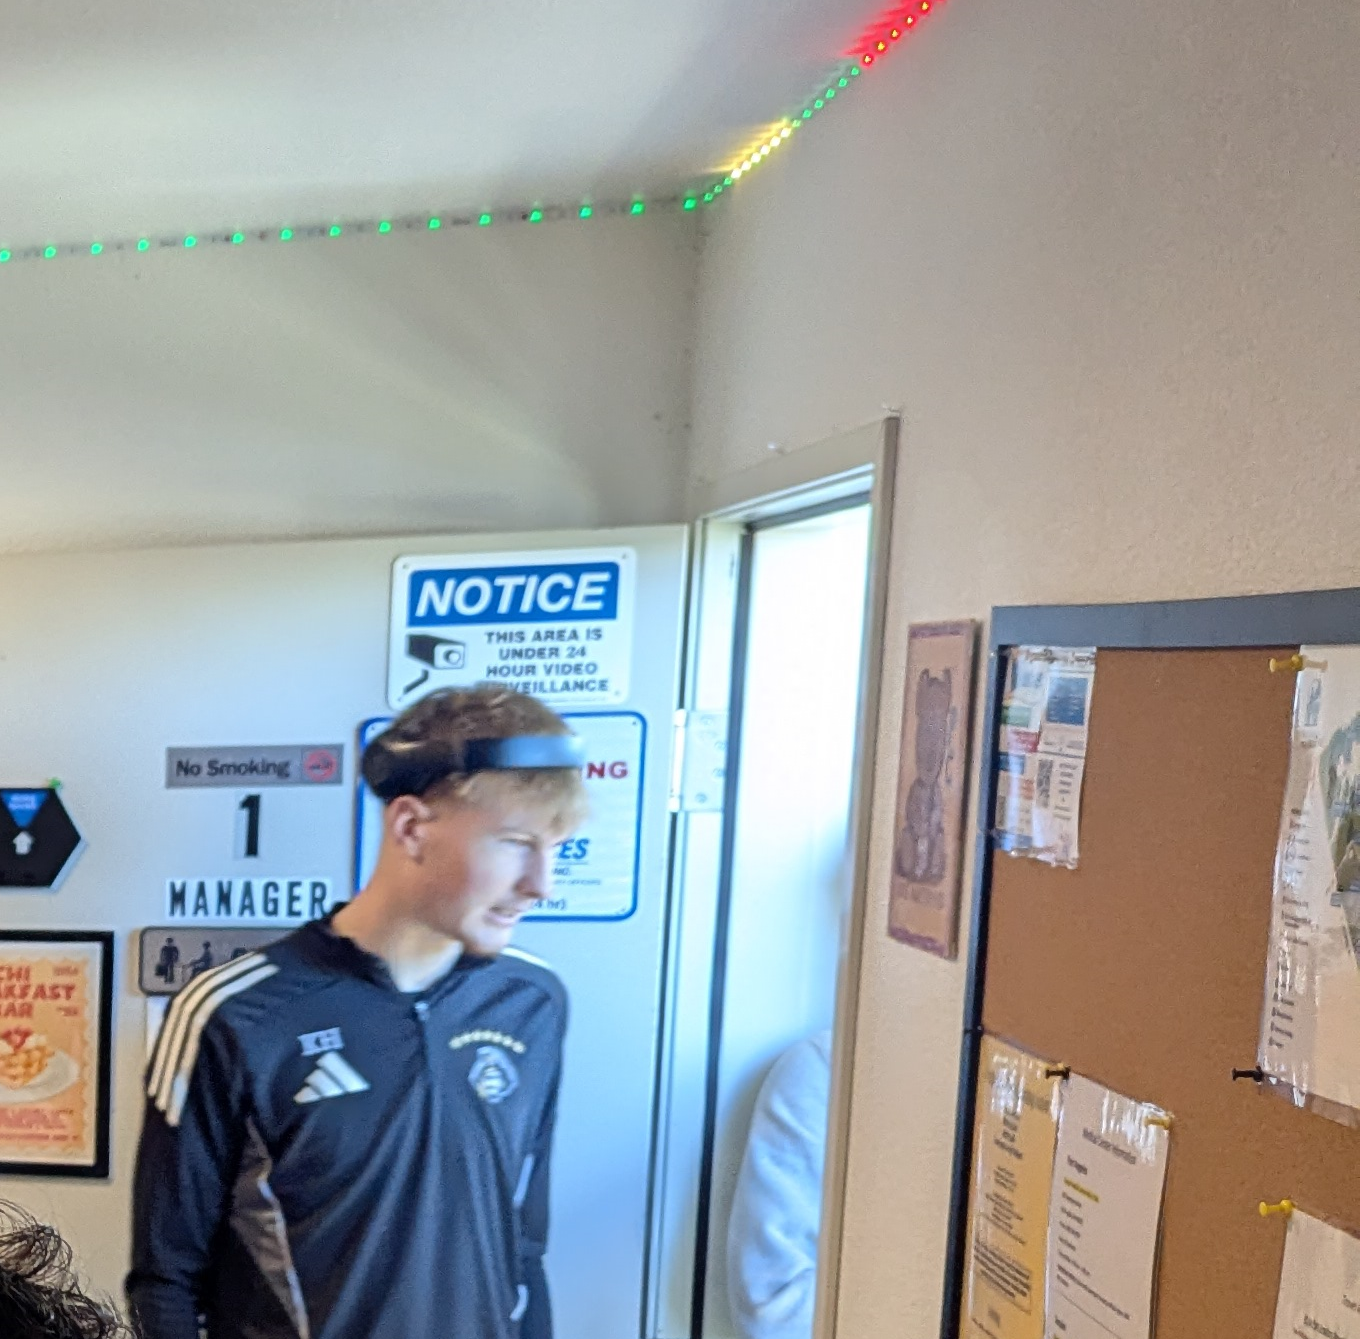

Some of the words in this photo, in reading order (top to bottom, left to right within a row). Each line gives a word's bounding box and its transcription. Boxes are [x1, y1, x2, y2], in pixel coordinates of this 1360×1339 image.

[415, 572, 611, 617] NOTICE
[485, 631, 526, 644] THIS
[531, 629, 578, 642] AREA
[585, 628, 603, 641] IS
[499, 647, 560, 660] UNDER
[566, 646, 586, 659] 24
[486, 664, 536, 677] HOUR
[544, 662, 598, 676] VIDEO
[175, 760, 202, 776] No
[207, 758, 291, 780] Smoking
[237, 794, 262, 857] 1
[168, 880, 330, 917] MANAGER
